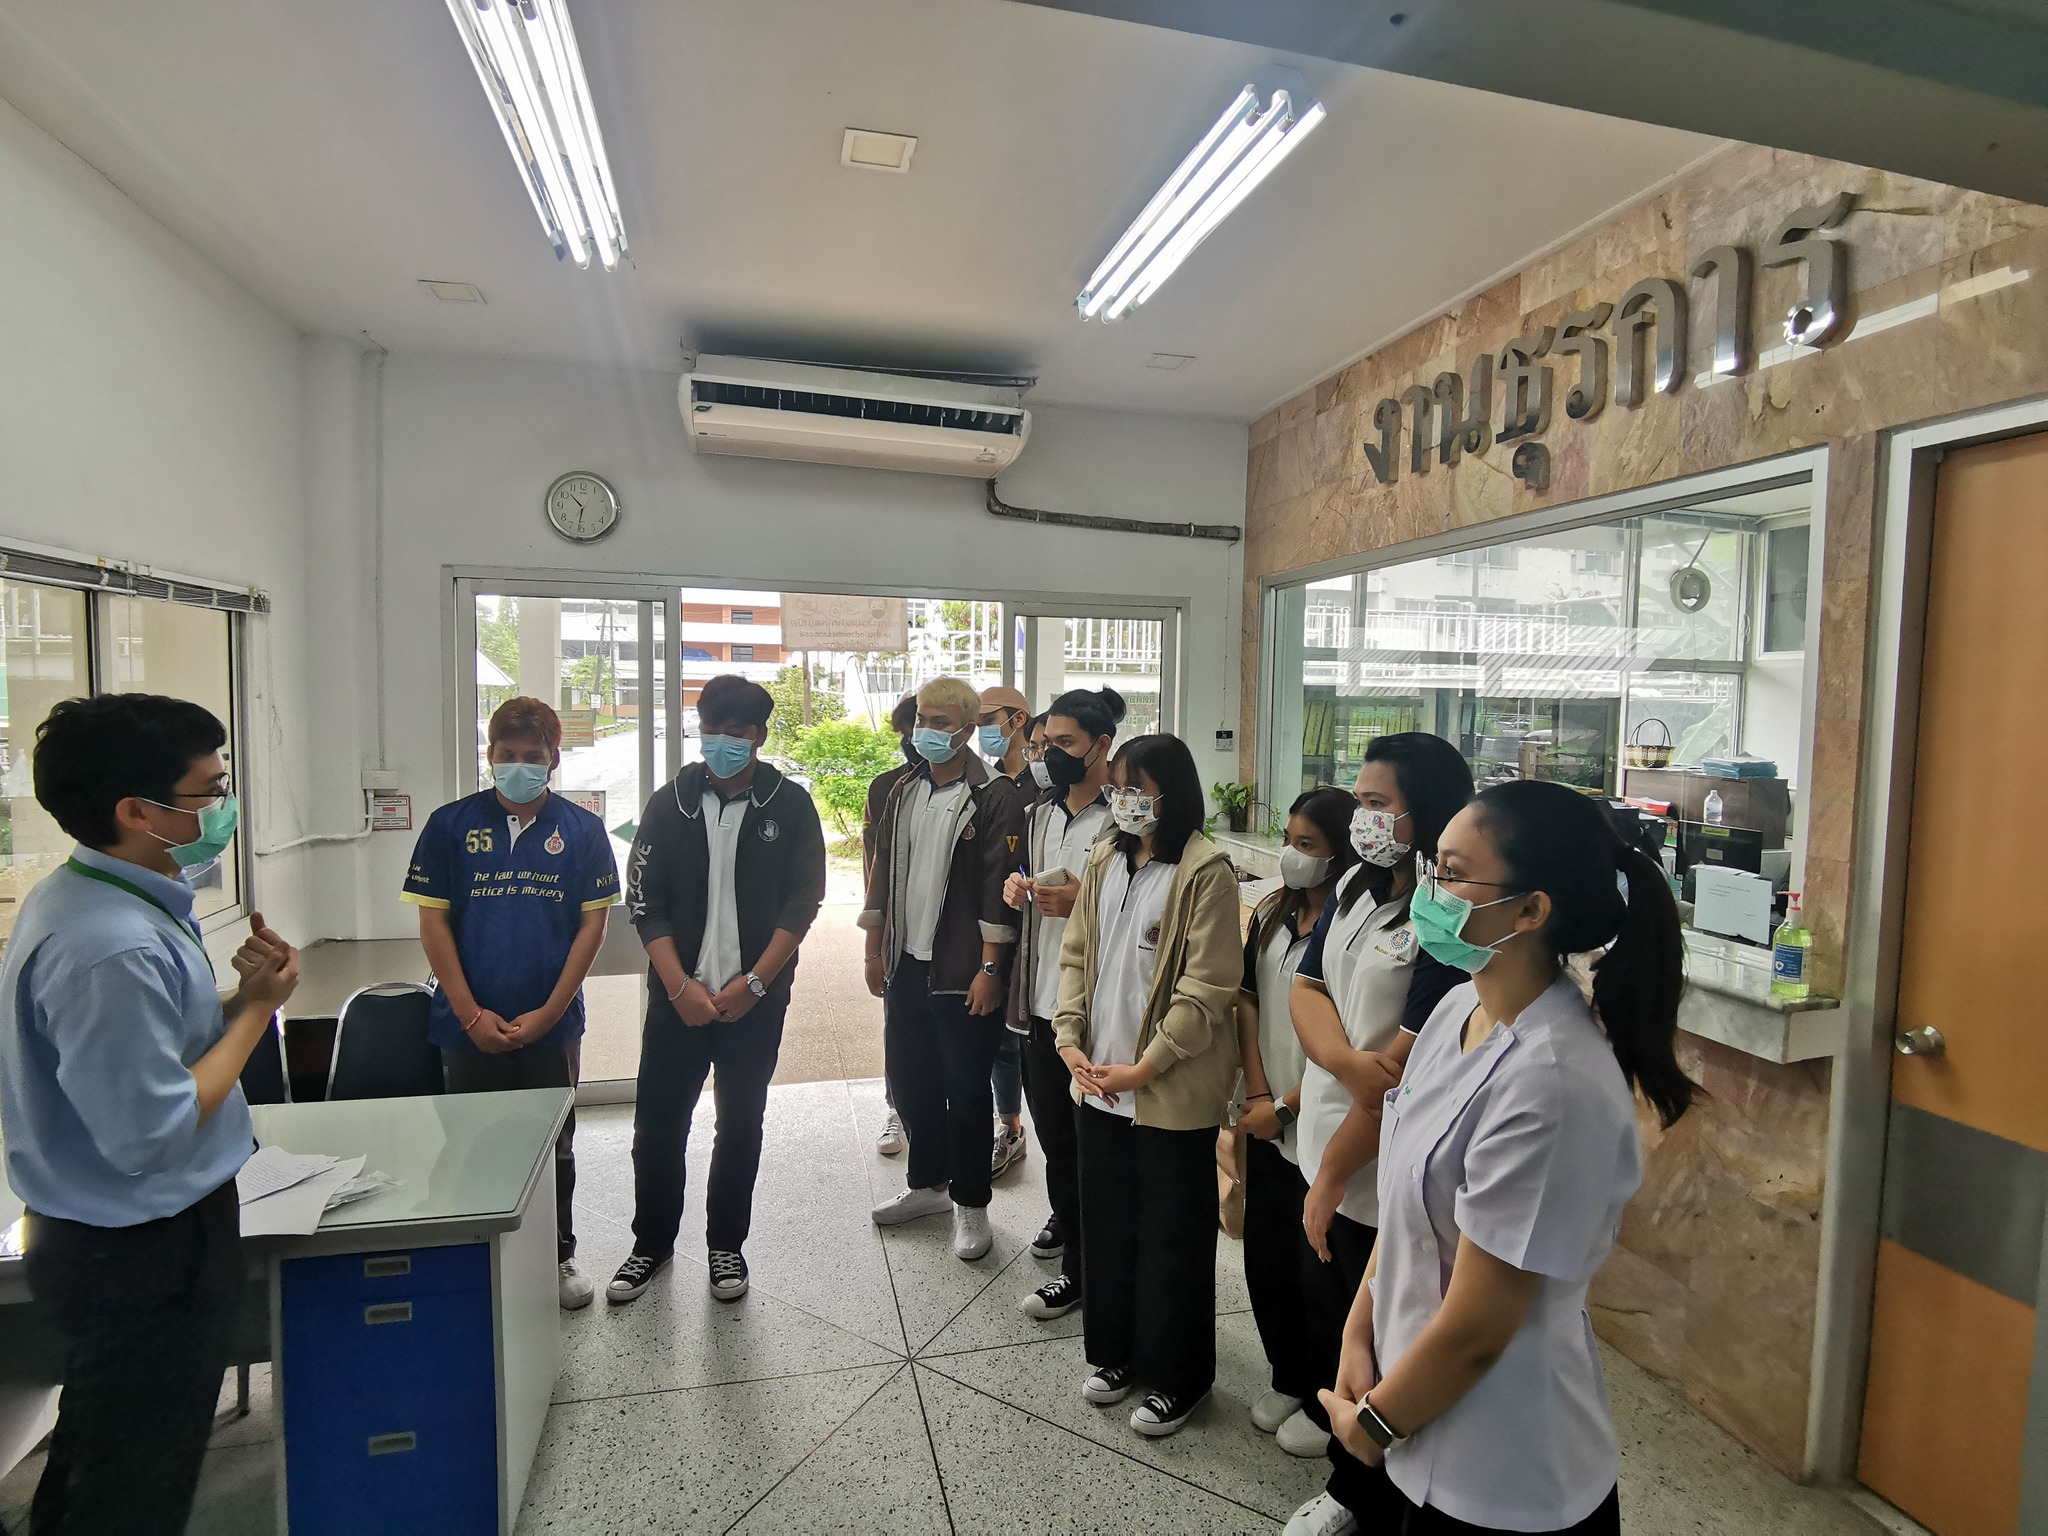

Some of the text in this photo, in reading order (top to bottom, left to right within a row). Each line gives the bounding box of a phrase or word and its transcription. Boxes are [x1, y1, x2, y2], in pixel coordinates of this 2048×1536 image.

[1364, 191, 1857, 491] งานธุรการ
[569, 484, 576, 492] 11
[560, 490, 569, 499] 10
[557, 501, 564, 510] 9
[560, 513, 567, 521] 8
[598, 516, 604, 524] 4
[465, 828, 493, 854] 55
[1005, 835, 1019, 853] V
[494, 870, 514, 881] law
[506, 884, 518, 896] is
